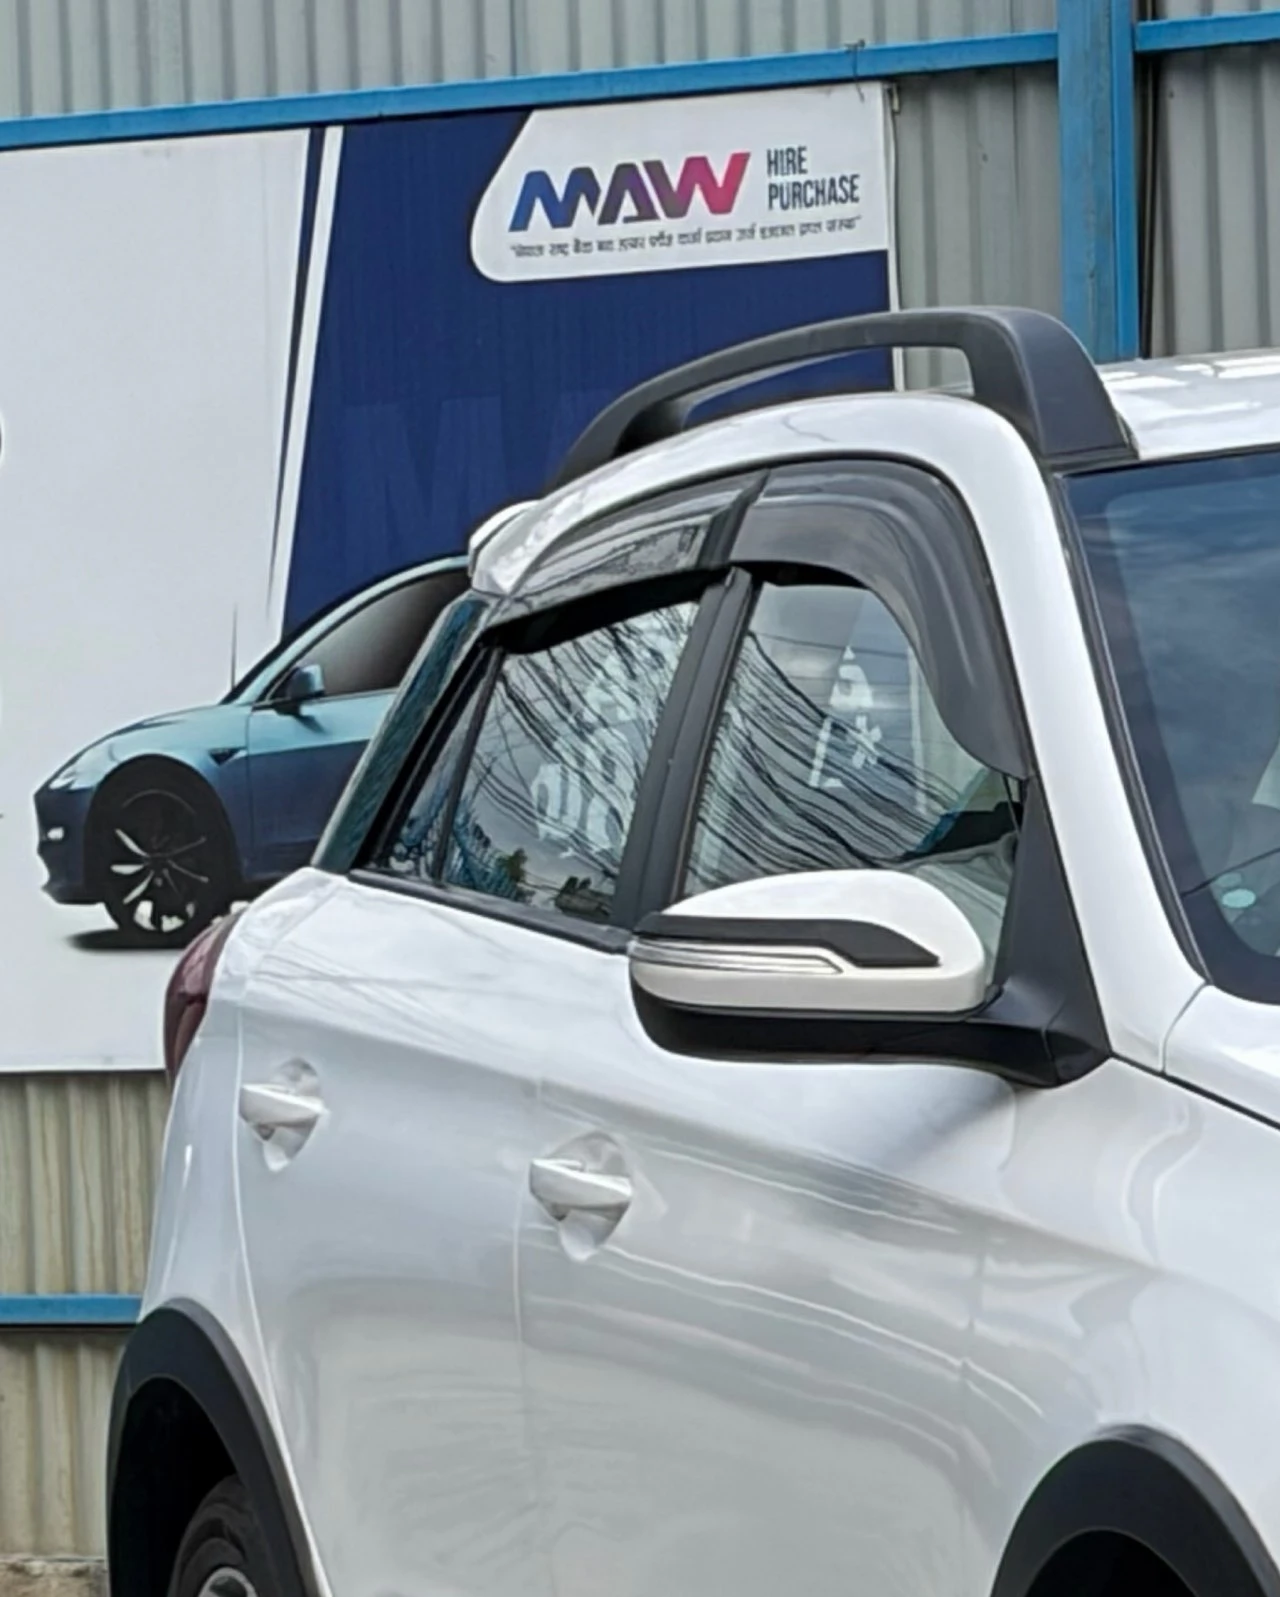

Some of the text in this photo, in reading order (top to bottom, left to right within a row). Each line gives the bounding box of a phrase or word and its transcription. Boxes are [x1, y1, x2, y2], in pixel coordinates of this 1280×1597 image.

[766, 146, 808, 176] HIRE
[509, 151, 751, 232] MAW
[767, 173, 860, 211] PURCHASE
